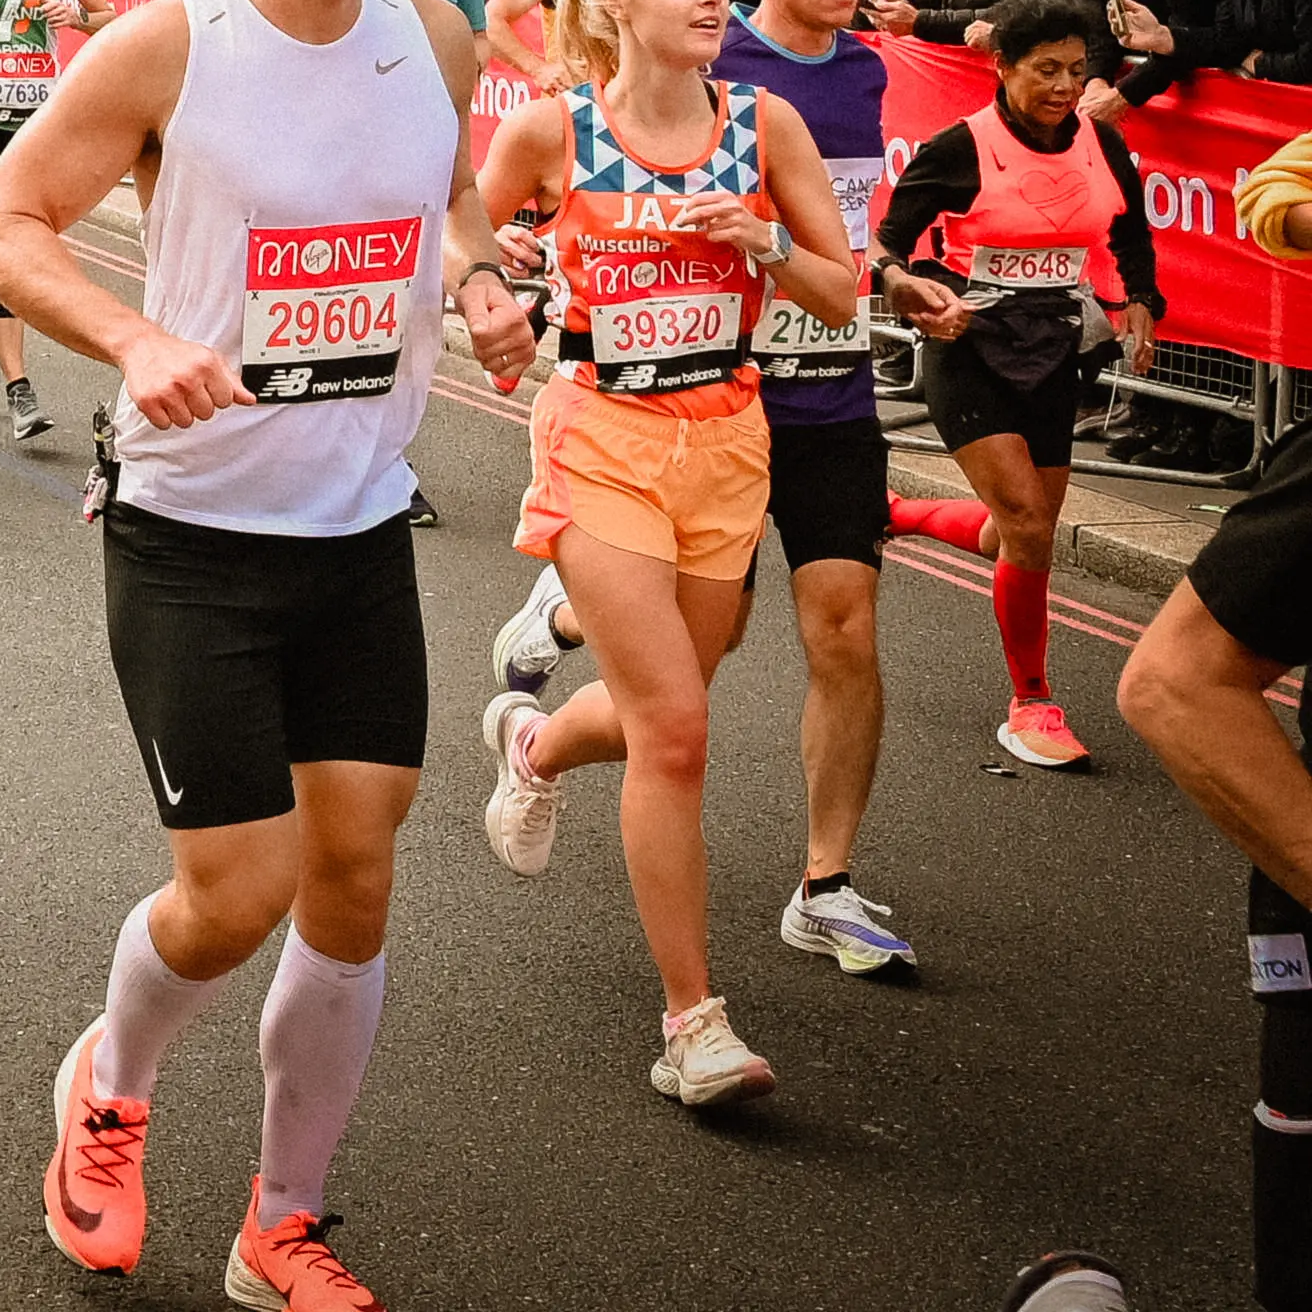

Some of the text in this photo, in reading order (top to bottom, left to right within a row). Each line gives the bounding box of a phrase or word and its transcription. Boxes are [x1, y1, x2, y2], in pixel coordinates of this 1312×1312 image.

[257, 228, 414, 277] MONEY
[577, 233, 672, 254] Muscular
[595, 260, 735, 295] MONEY
[988, 251, 1071, 279] 52648
[265, 291, 397, 348] 29604
[612, 303, 723, 352] 39320
[312, 380, 341, 395] new
